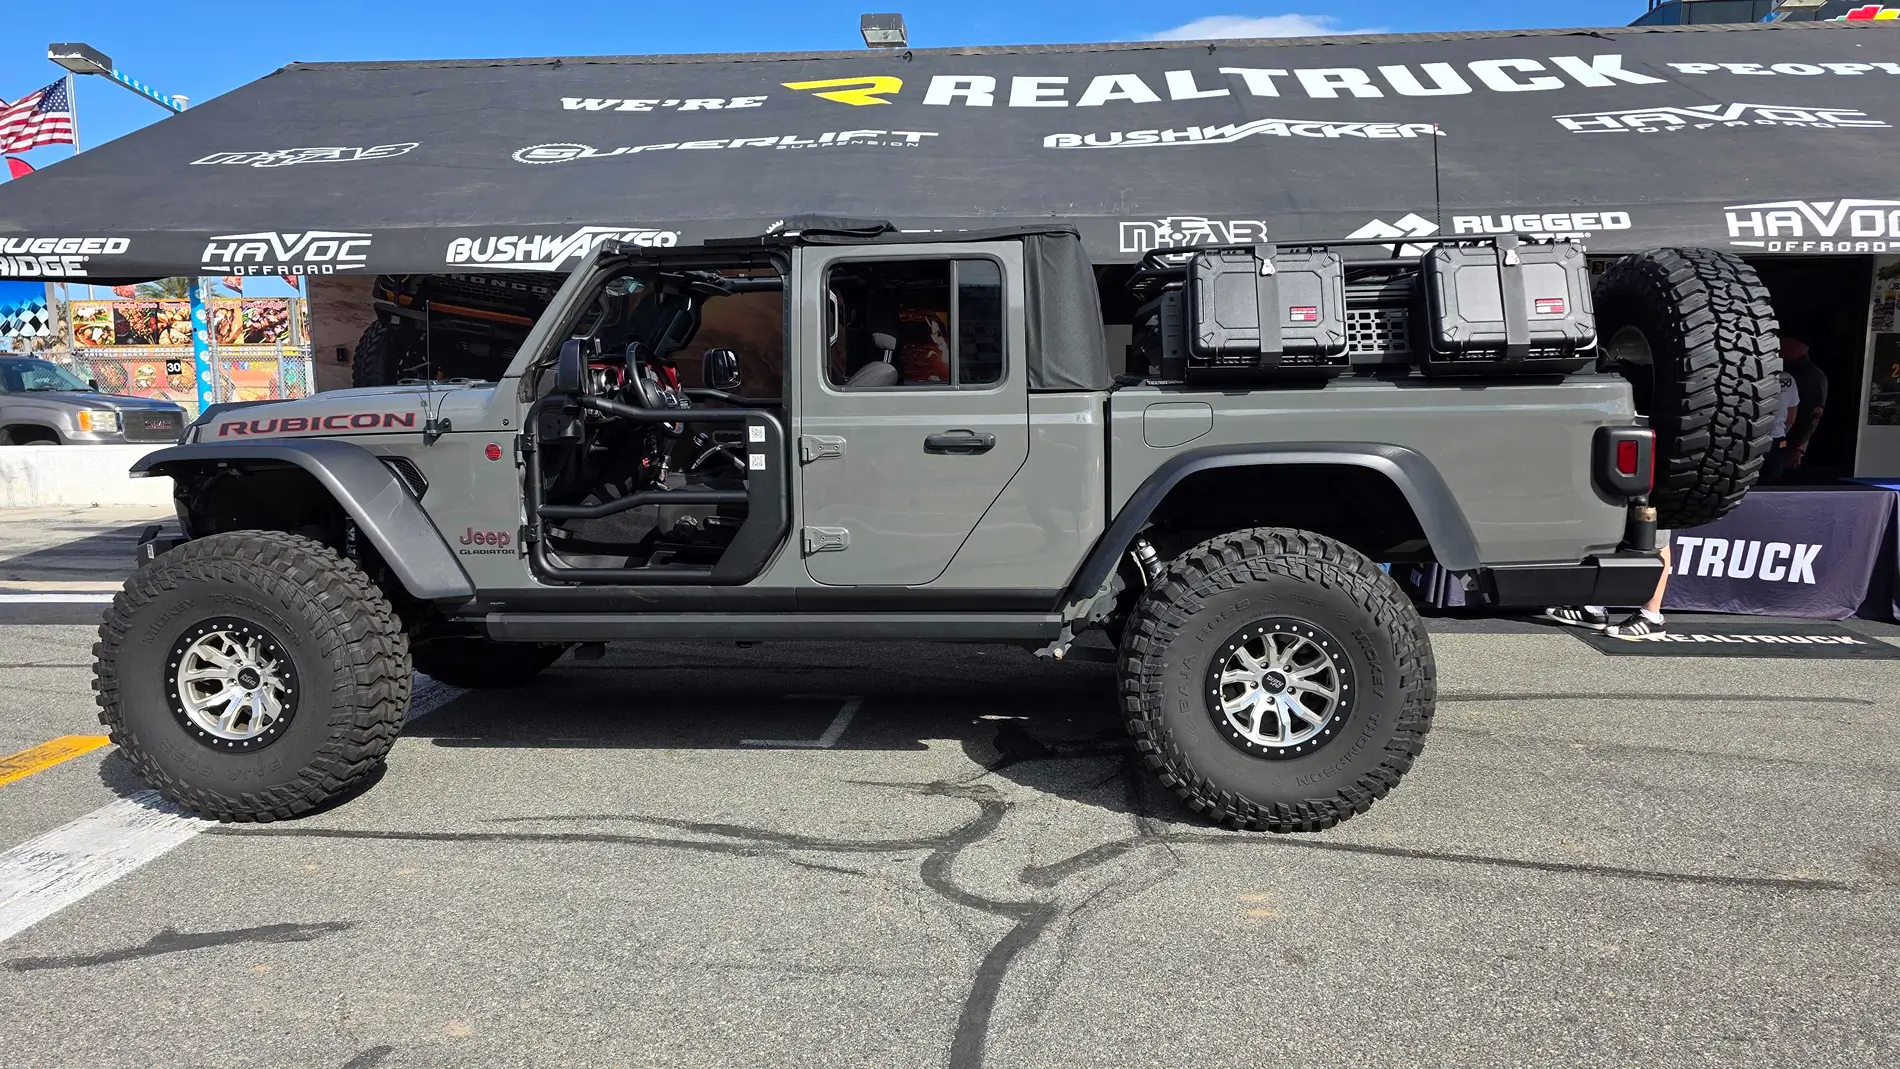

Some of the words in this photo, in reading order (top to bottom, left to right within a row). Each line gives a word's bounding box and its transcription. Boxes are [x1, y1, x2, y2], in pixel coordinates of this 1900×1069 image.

[560, 96, 768, 111] WE'RE
[923, 54, 1668, 107] REALTRUCK
[1552, 103, 1892, 129] HAVOC
[1637, 119, 1836, 133] OFFROAD
[1043, 118, 1447, 148] BUSHWACKER
[512, 129, 940, 164] SUPERLIFT
[775, 140, 920, 150] SUSPENSION
[1452, 212, 1632, 234] RUGGED
[201, 231, 373, 262] HAVOC
[1767, 241, 1887, 252] OFFROAD
[233, 265, 334, 275] OFFROAD
[167, 363, 181, 372] 30
[218, 412, 416, 437] RUBICON
[460, 527, 511, 548] Jeep
[1670, 536, 1823, 585] TRUCK
